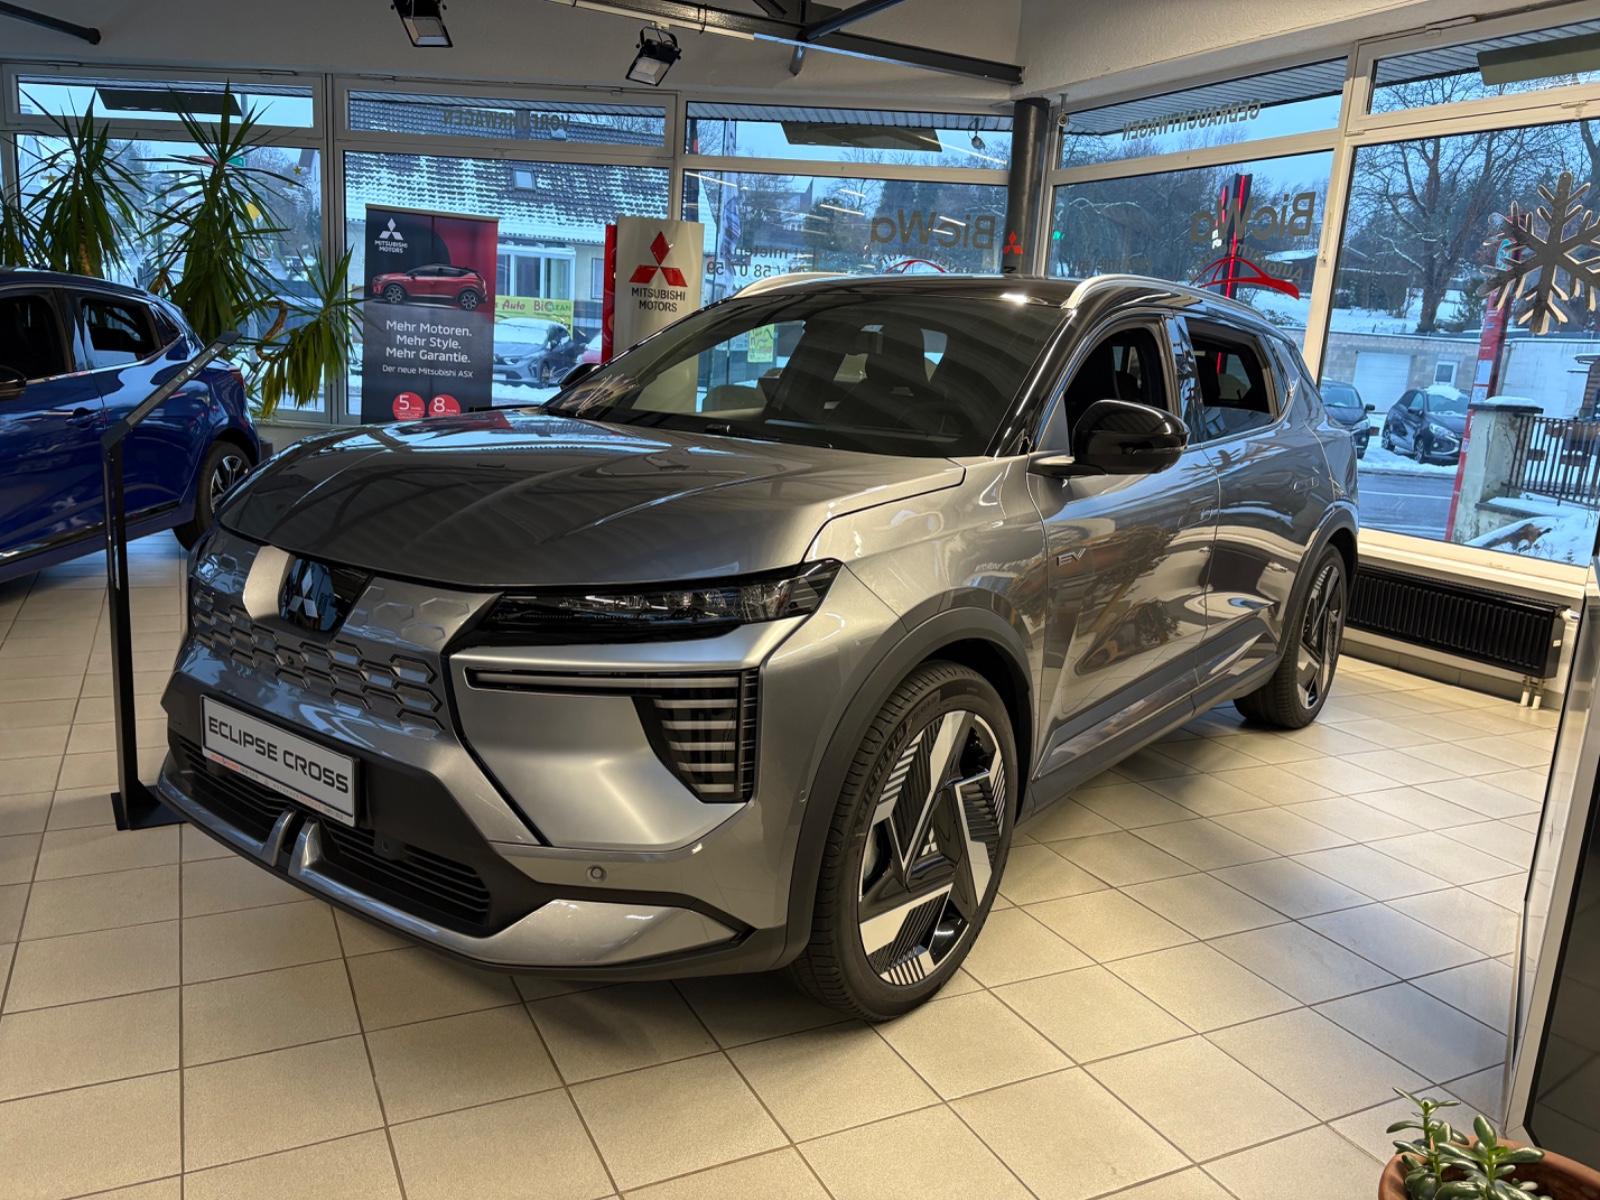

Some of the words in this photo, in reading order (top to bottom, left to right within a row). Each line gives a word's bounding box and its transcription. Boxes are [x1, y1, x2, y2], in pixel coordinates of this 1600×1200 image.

[375, 239, 408, 249] MITSUBISHI
[378, 246, 404, 254] MOTORS
[631, 286, 686, 302] MITSUBISHI
[502, 299, 526, 311] Auto
[639, 300, 678, 313] MOTORS
[386, 320, 416, 332] Mehr
[419, 322, 473, 337] Motoren.
[396, 335, 426, 347] Mehr
[429, 336, 462, 350] Style.
[385, 347, 416, 359] Mehr
[419, 348, 471, 364] Garantie.
[382, 364, 396, 373] Der
[397, 367, 416, 375] neue
[418, 367, 457, 377] Mitsubishi
[458, 369, 473, 378] ASX
[398, 394, 410, 411] 5
[433, 397, 446, 413] 8
[1056, 547, 1087, 568] EV
[208, 715, 279, 762] ECLIPSE
[283, 749, 350, 794] CROSS
